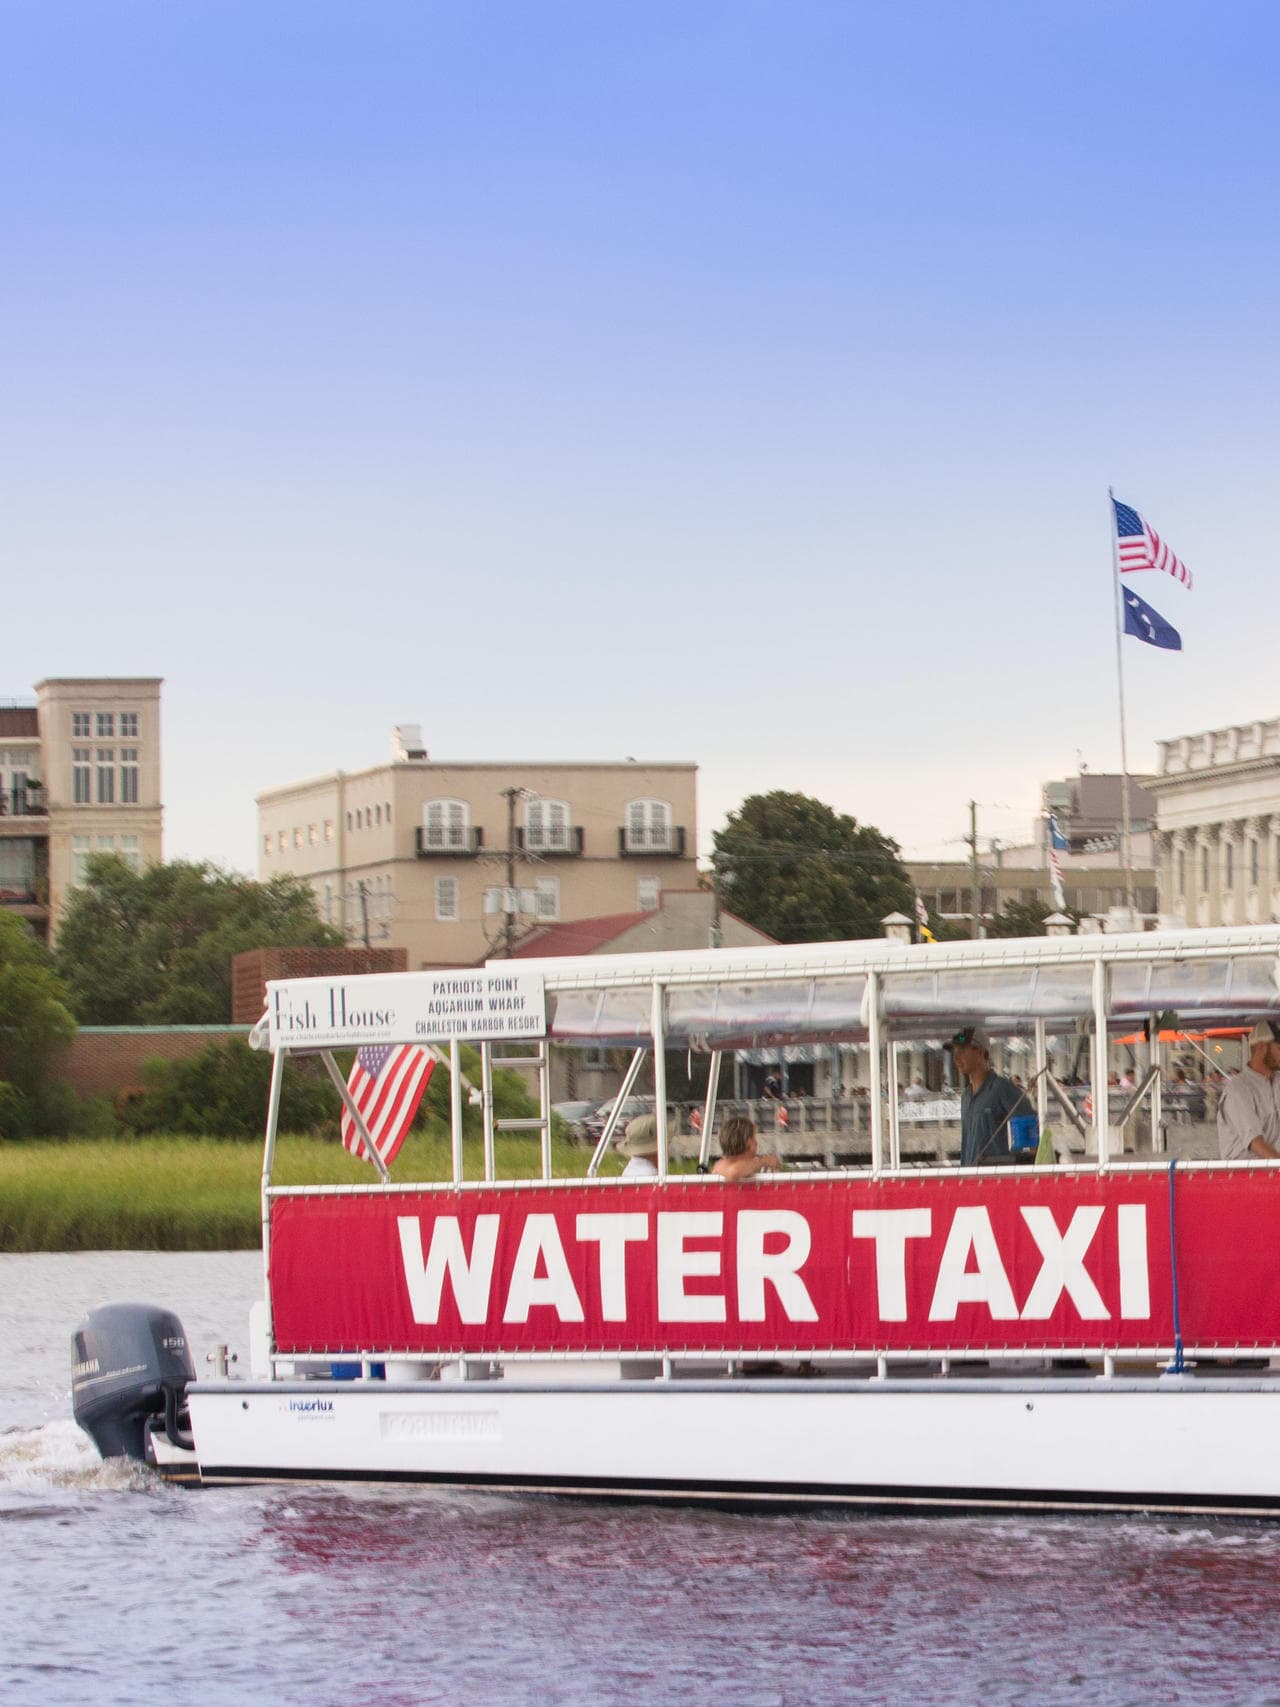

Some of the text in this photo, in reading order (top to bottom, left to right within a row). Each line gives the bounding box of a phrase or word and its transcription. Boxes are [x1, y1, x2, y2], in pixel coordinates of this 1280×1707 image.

[433, 977, 520, 995] PATRIOTS POINT
[274, 985, 397, 1030] Fish House
[428, 996, 526, 1015] AQUARIUM WHARF
[415, 1015, 541, 1034] CHARLESTON HARBOR RESORT
[397, 1204, 1150, 1325] WATER TAXI
